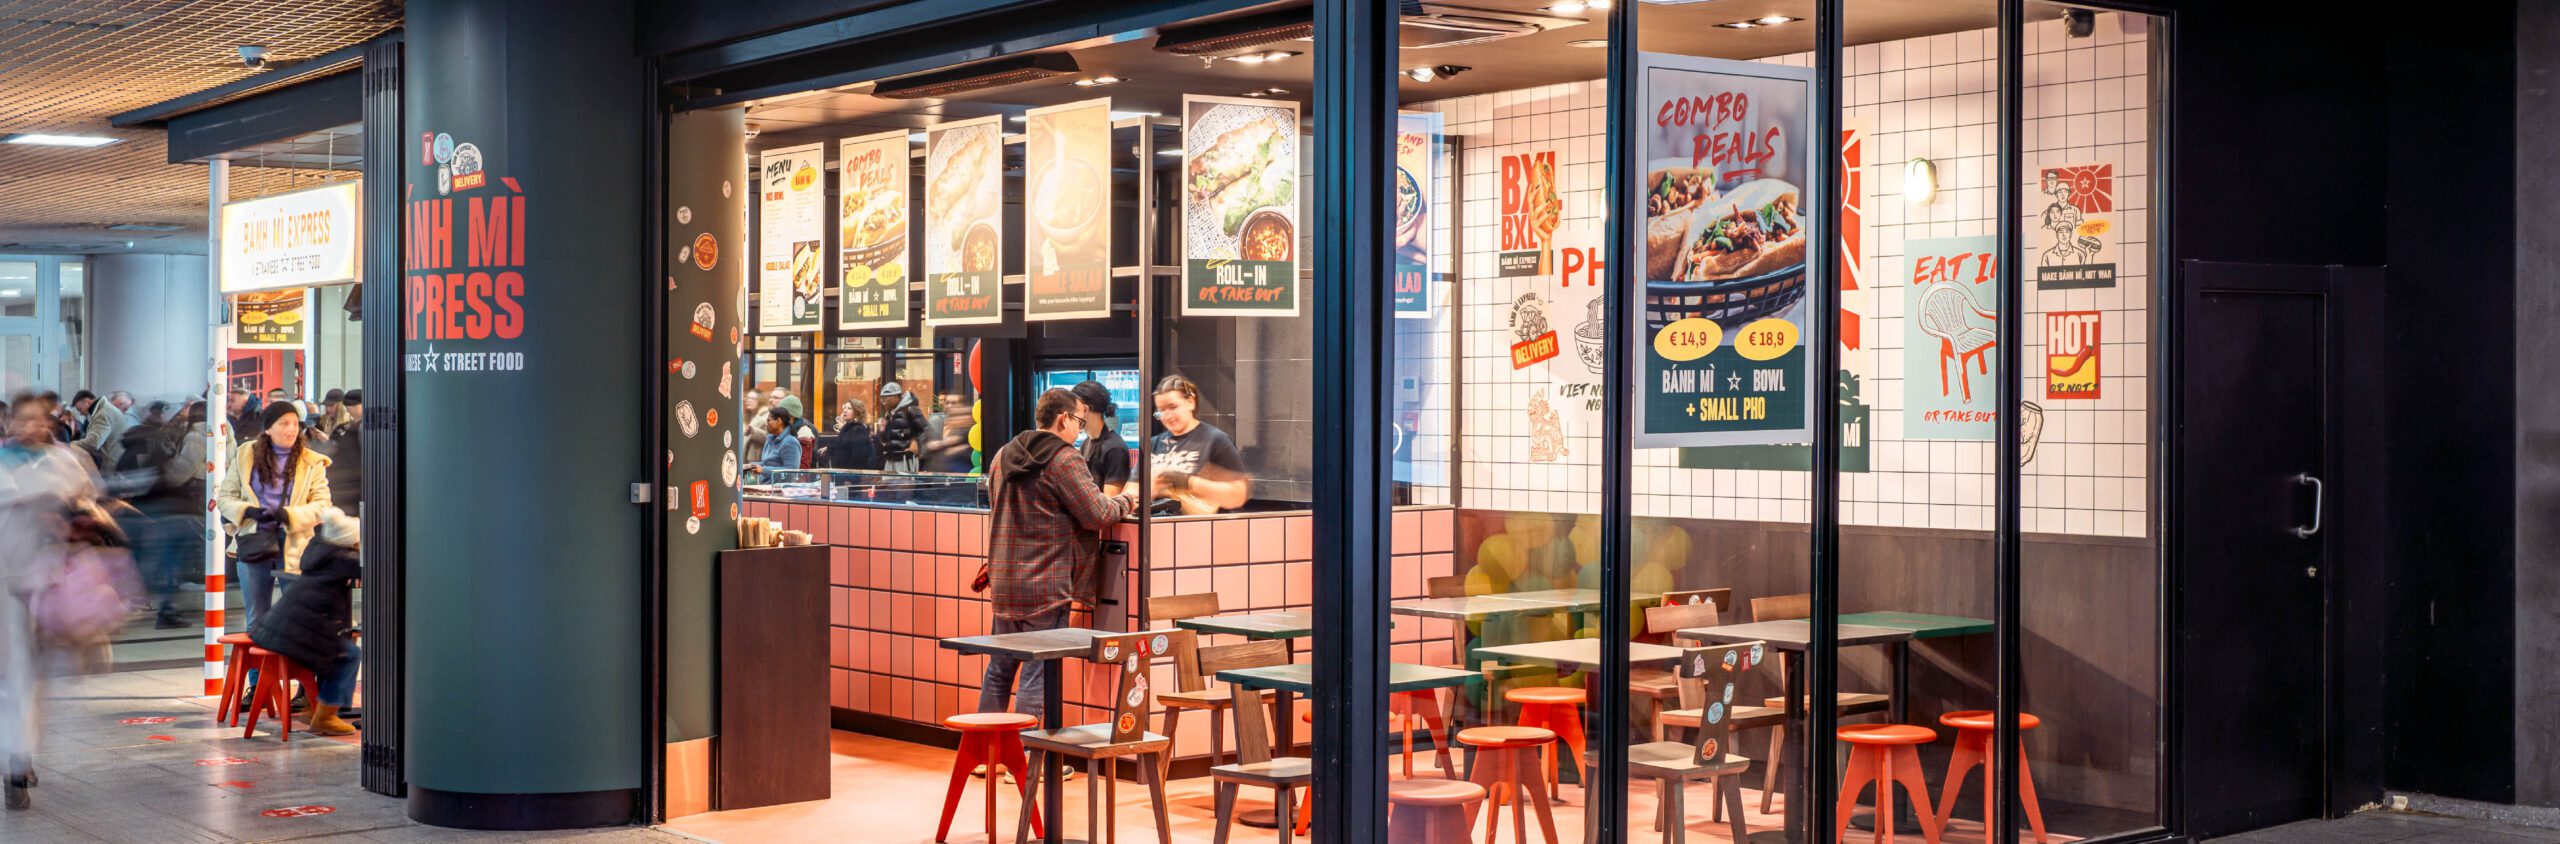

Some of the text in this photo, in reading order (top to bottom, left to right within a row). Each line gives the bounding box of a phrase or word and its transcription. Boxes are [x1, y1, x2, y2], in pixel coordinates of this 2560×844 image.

[1656, 91, 1749, 131] COMBO
[1692, 126, 1780, 170] DEALS
[766, 159, 792, 179] MENU
[846, 149, 881, 174] COMBO
[454, 174, 483, 189] DELIVERY
[860, 163, 895, 190] DEALS
[243, 207, 331, 255] BÁNH MÌ EXPRESS
[468, 177, 525, 267] MÌ
[1501, 214, 1538, 251] BXL
[309, 253, 320, 270] FOOD
[1913, 252, 1973, 285] EAT
[946, 275, 980, 297] ROLL-IN
[1216, 264, 1267, 286] ROLL-IN
[2041, 272, 2058, 282] MAKE
[2085, 270, 2096, 280] NOT
[2097, 269, 2112, 279] WAR
[950, 297, 970, 312] TAKE
[1199, 285, 1285, 304] OR TAKE OUT
[1669, 331, 1707, 348] € 14,9
[1748, 331, 1785, 348] € 18,9
[2048, 314, 2099, 356] HOT
[443, 352, 486, 371] STREET
[489, 352, 524, 371] FOOD
[1514, 336, 1554, 365] DELIVERY
[1662, 363, 1786, 393] BÁNH MÌ BOWL
[2048, 382, 2066, 394] OR
[1559, 382, 1590, 399] VIET
[1686, 396, 1766, 421] + SMALL PHO
[1924, 409, 1996, 424] OR TAKE OUT
[1843, 416, 1862, 448] MÍ
